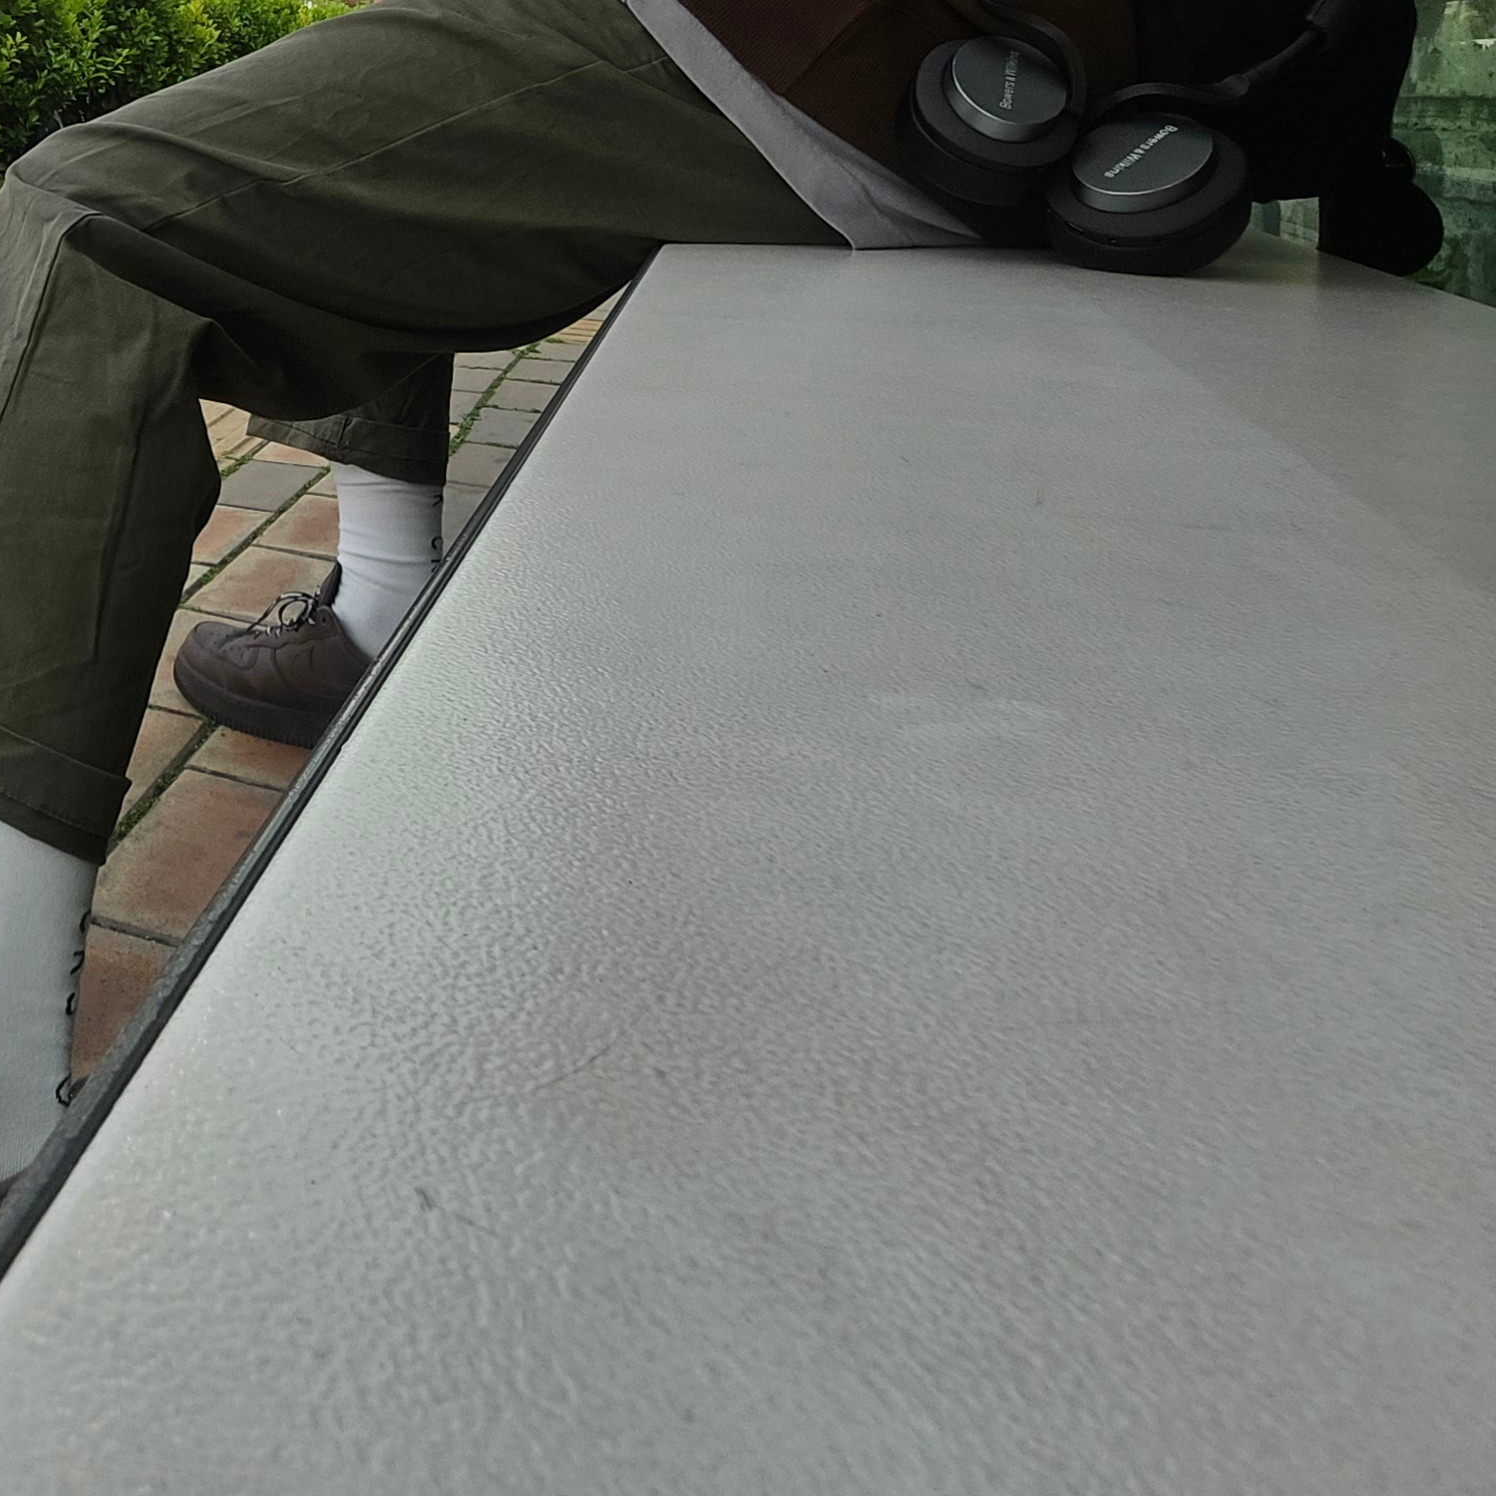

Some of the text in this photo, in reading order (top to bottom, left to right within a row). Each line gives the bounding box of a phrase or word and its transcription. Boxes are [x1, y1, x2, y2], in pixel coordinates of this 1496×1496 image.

[999, 81, 1016, 109] Bowers
[1140, 125, 1179, 150] Bowers
[1104, 152, 1143, 178] Wilkins
